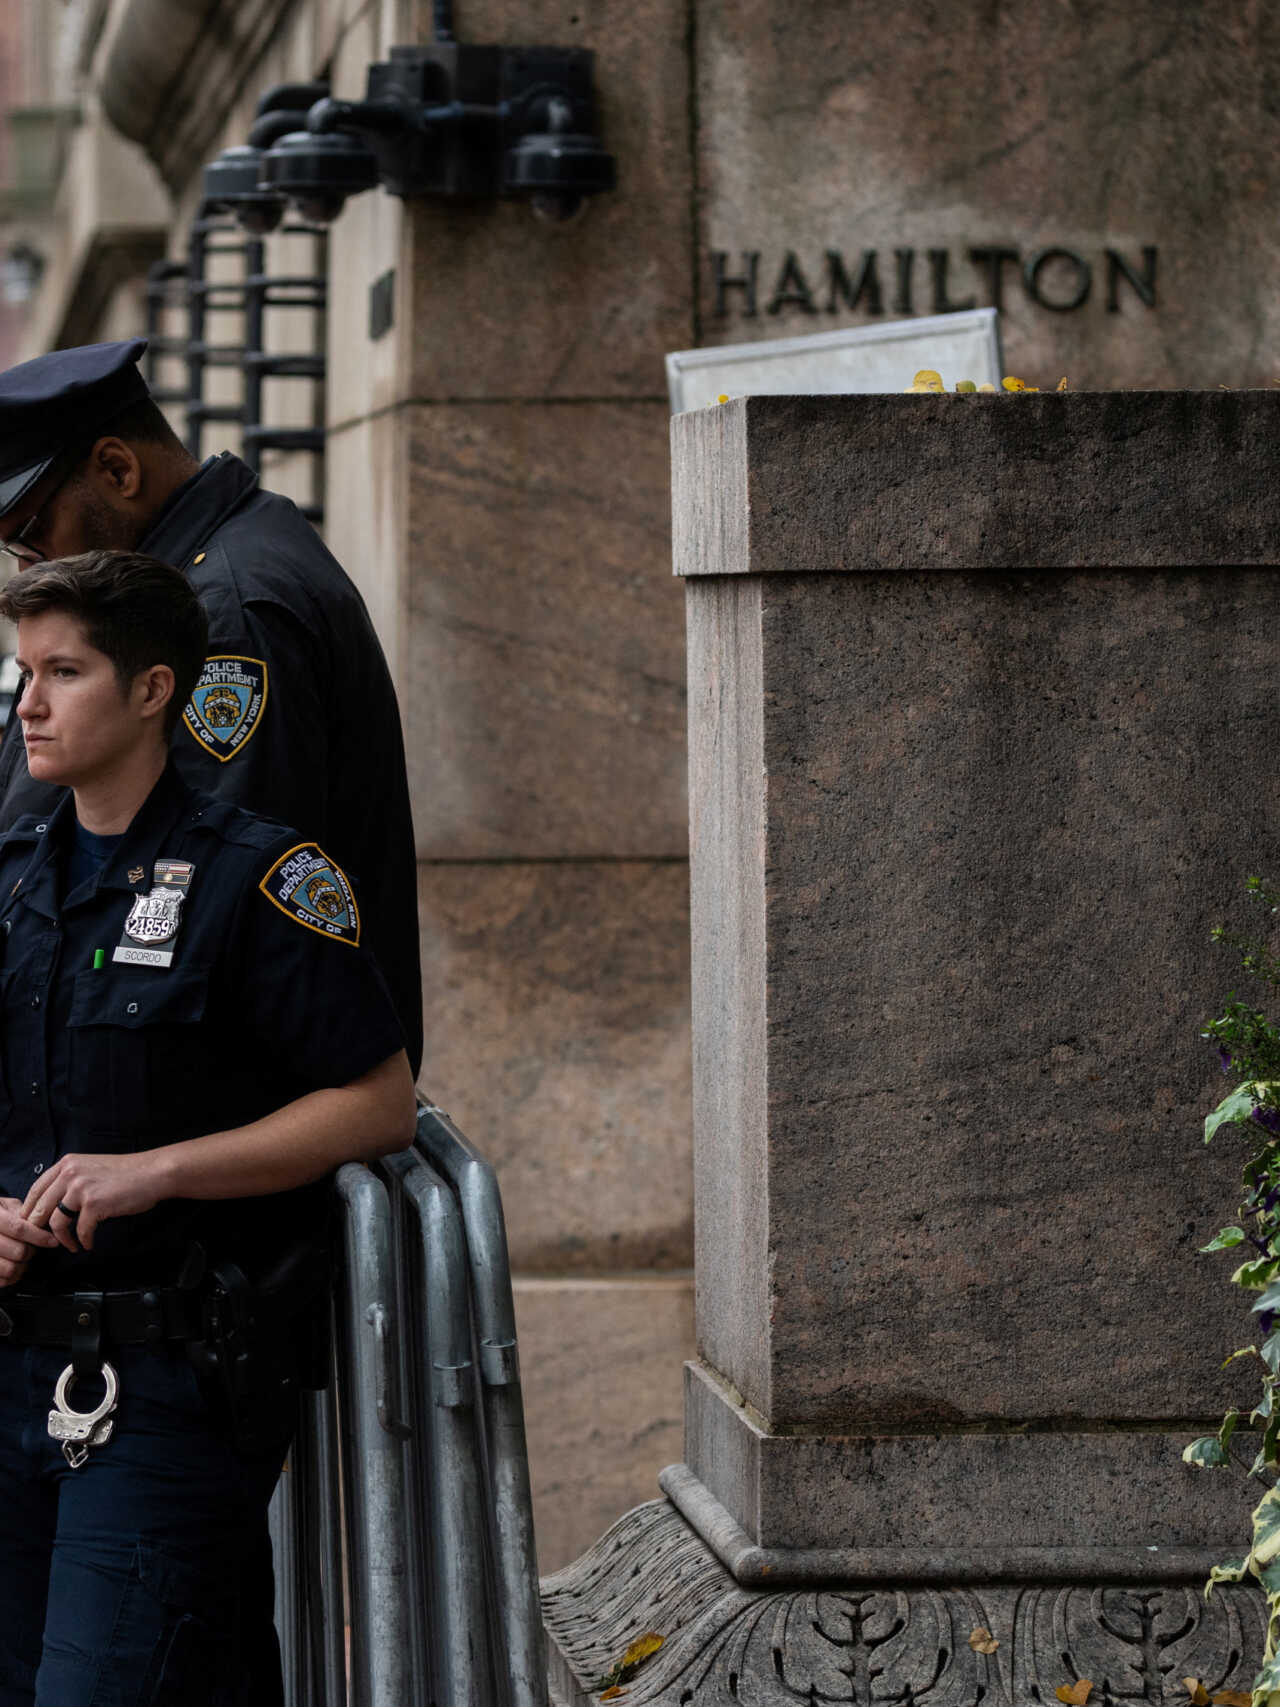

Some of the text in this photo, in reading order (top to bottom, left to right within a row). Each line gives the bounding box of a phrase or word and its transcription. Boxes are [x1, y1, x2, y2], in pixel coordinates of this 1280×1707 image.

[711, 245, 1158, 317] HAMILTON
[185, 704, 215, 743] CITY OF
[230, 694, 262, 747] NEW YORK
[280, 851, 313, 879] POLICE
[296, 909, 342, 934] CITY OF
